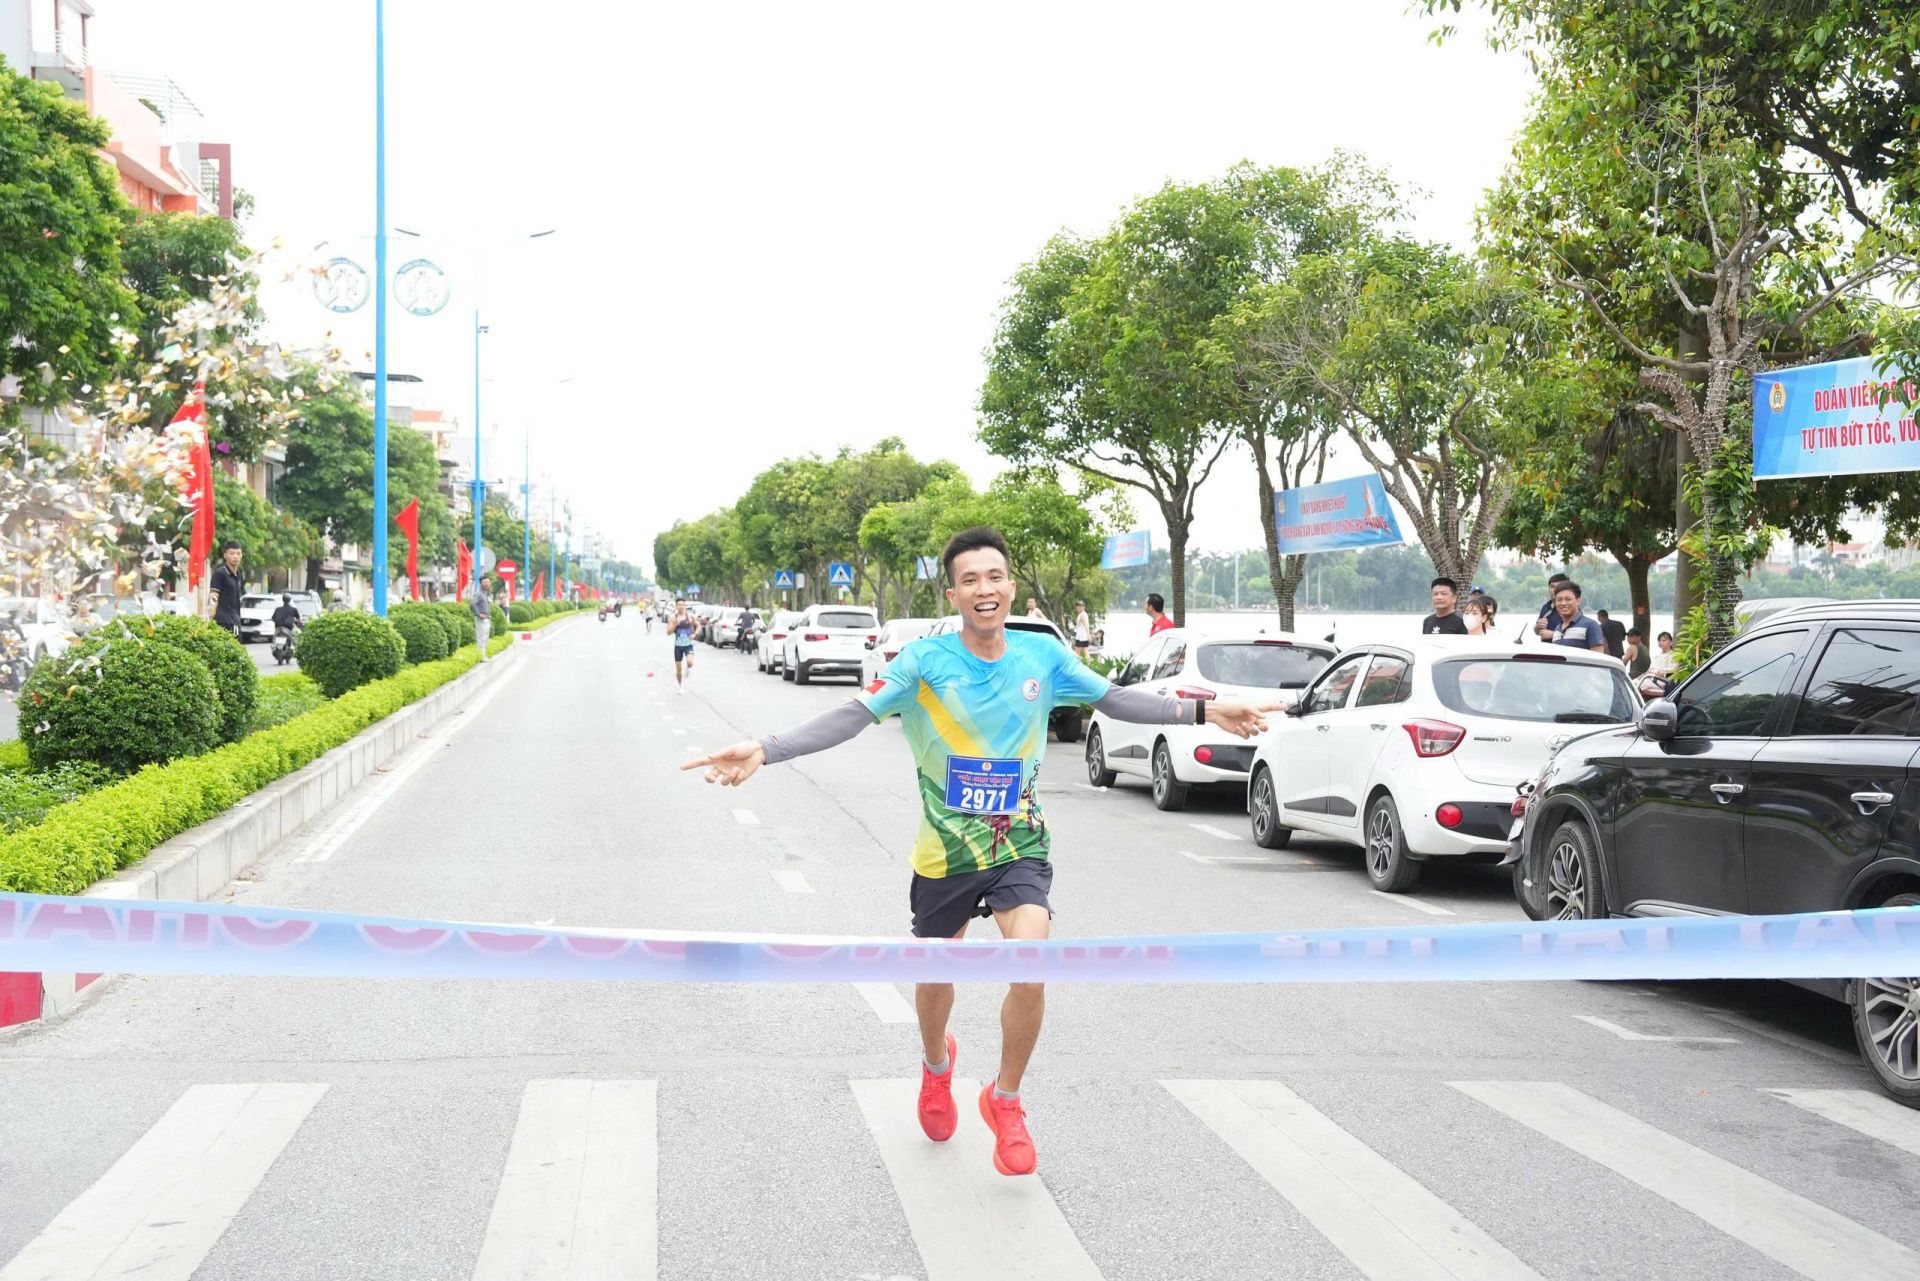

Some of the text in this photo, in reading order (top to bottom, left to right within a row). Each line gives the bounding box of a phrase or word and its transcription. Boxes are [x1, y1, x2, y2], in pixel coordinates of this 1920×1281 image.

[1814, 384, 1846, 412] ĐOÀN
[1850, 380, 1878, 408] VIÊN
[1801, 426, 1816, 454] TỰ
[1818, 426, 1837, 449] TIN
[1841, 420, 1863, 447] BỨT
[1866, 414, 1896, 446] TỐC,
[960, 787, 1007, 811] 2971
